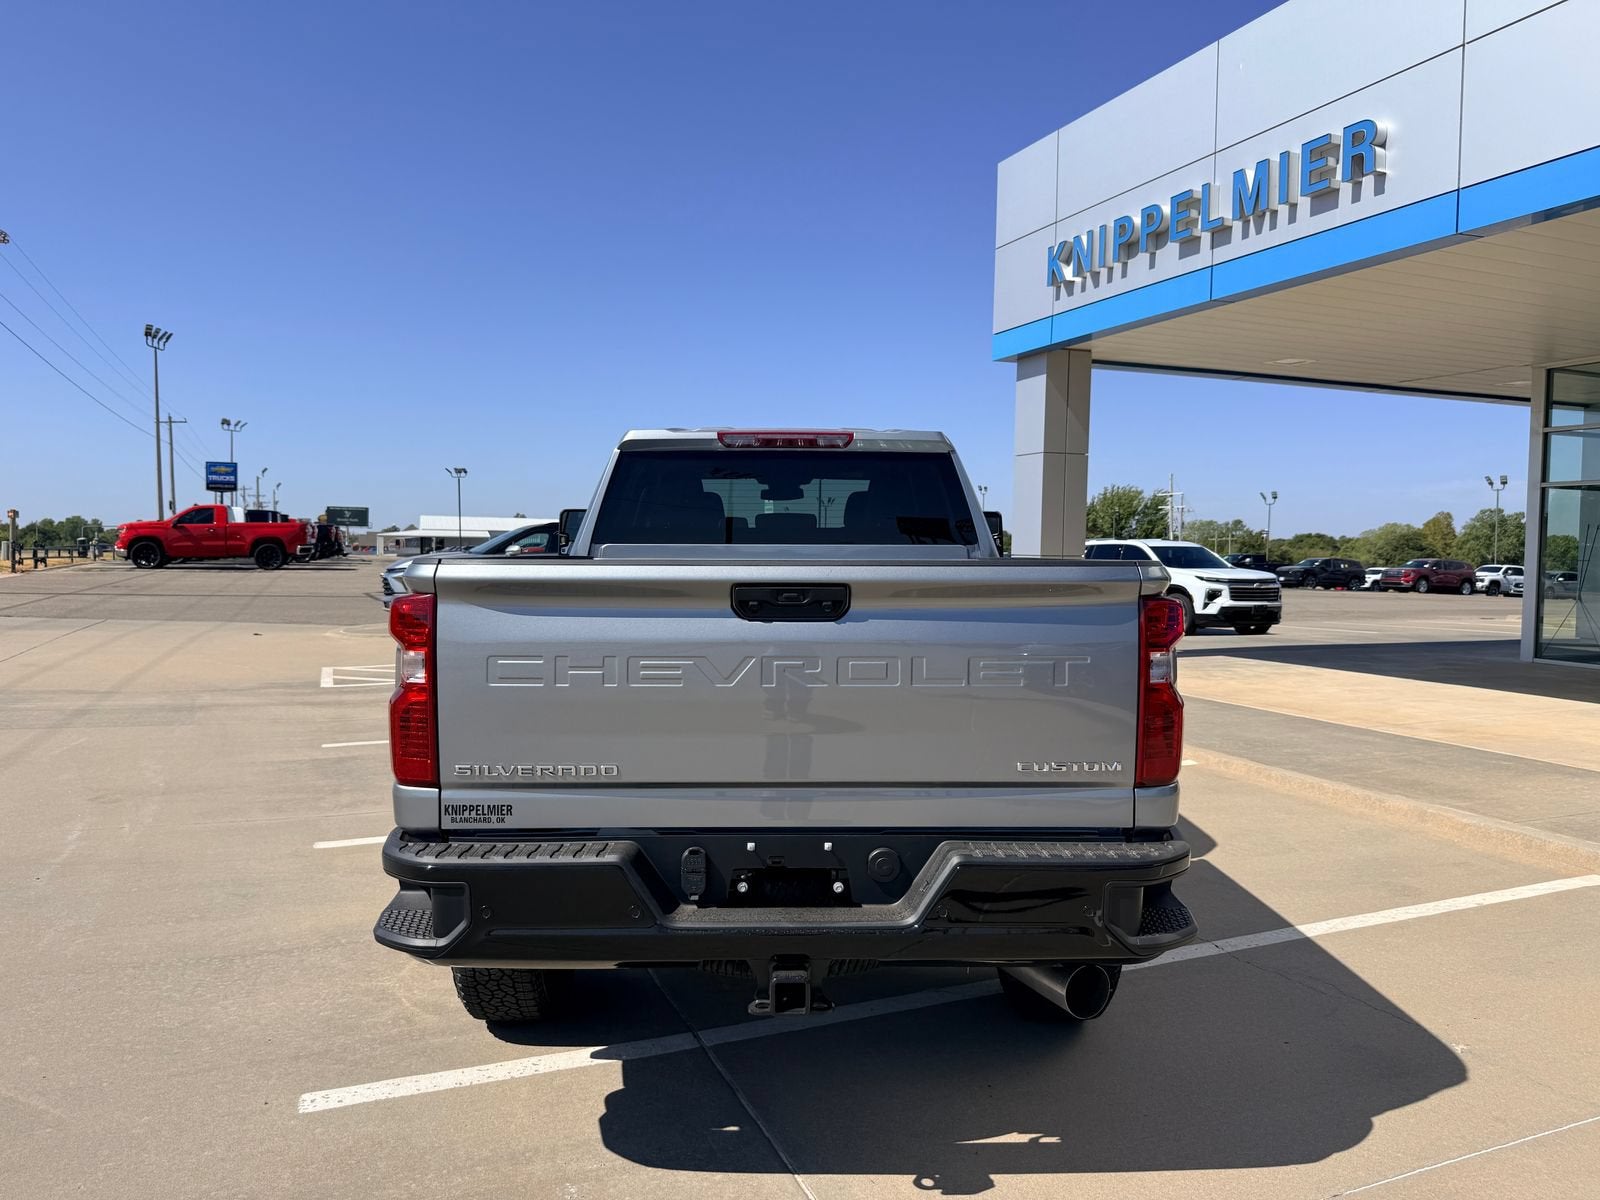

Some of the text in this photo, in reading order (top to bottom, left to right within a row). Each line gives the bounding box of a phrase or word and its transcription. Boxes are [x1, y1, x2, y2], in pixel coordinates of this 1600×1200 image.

[1047, 118, 1387, 287] KNIPPELMIER
[487, 655, 1091, 687] CHEVROLET
[453, 764, 619, 777] SILVERADO
[1016, 761, 1122, 772] CUSTOM
[444, 804, 513, 816] KNIPPELMIER
[450, 816, 506, 824] BLANCHARD, OK
